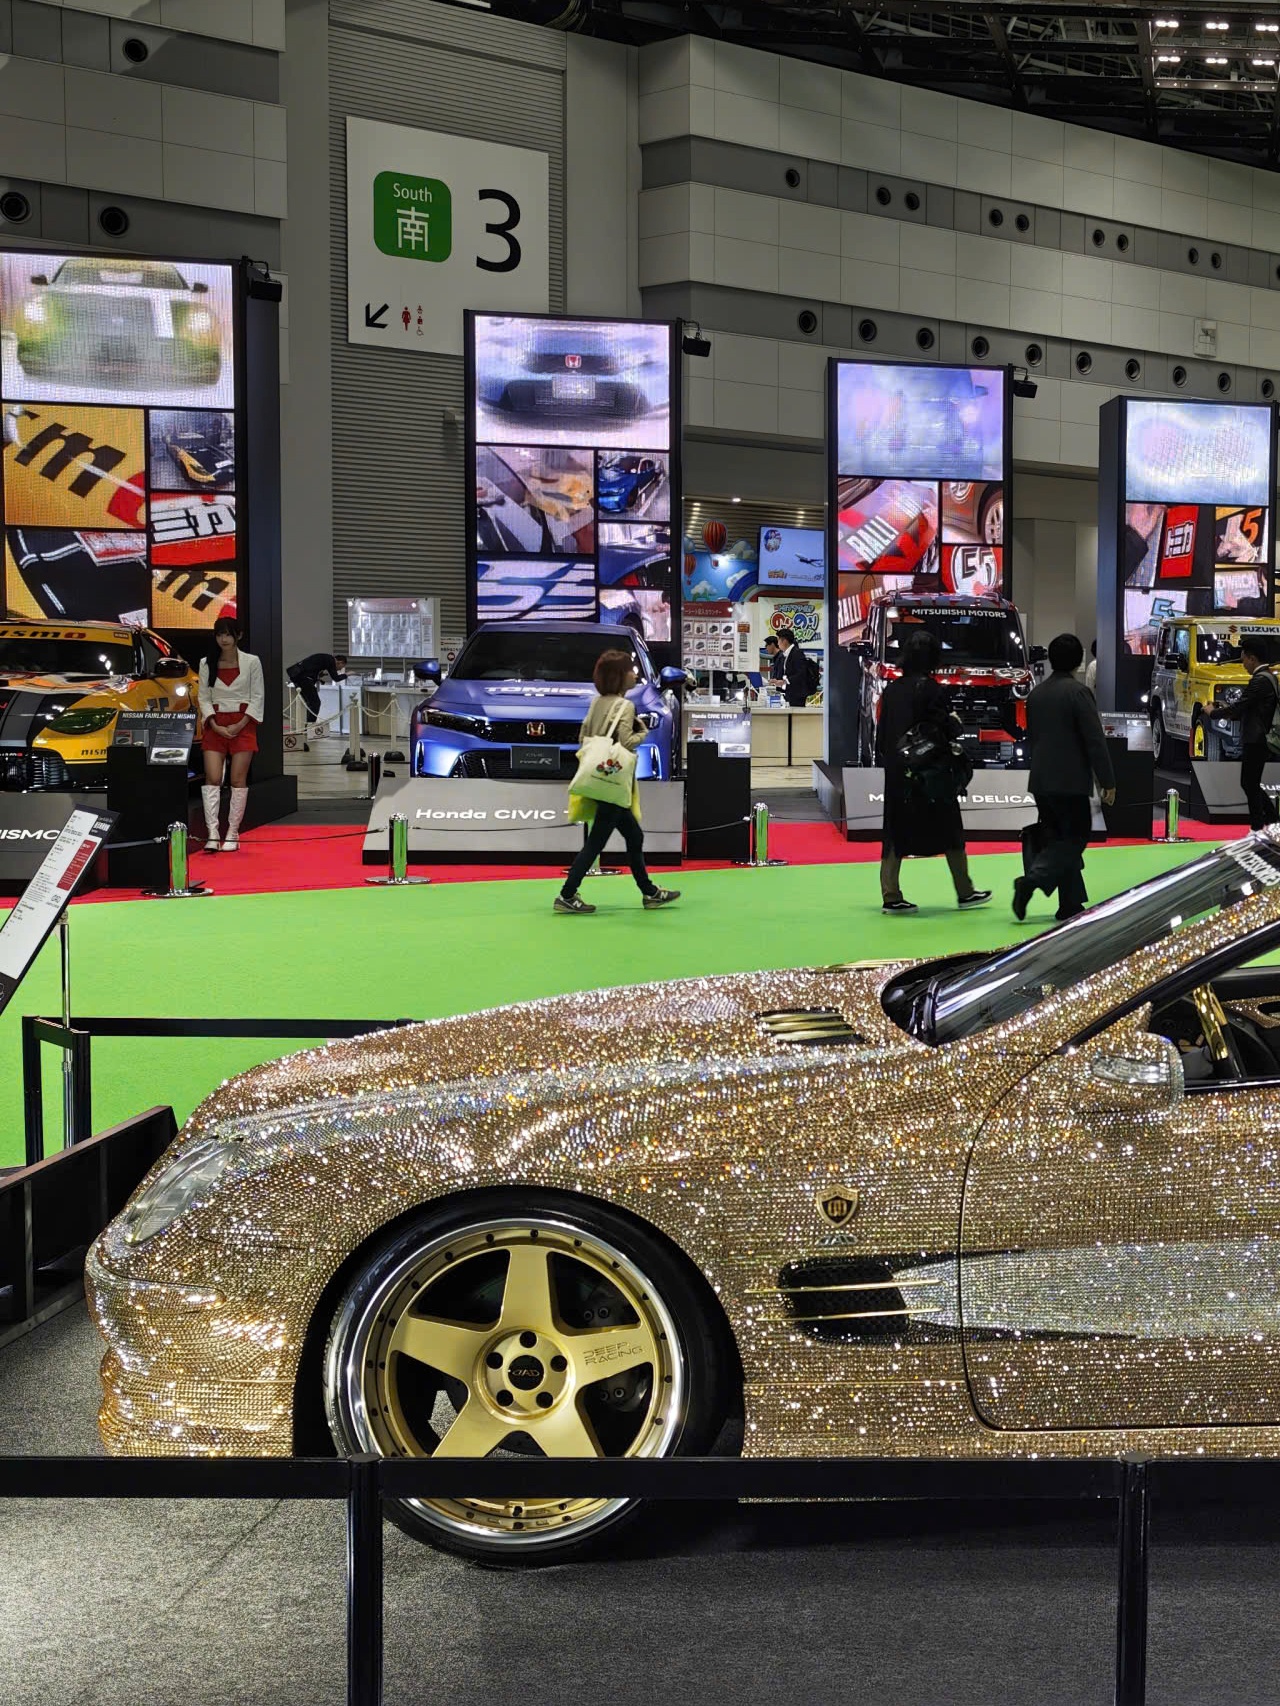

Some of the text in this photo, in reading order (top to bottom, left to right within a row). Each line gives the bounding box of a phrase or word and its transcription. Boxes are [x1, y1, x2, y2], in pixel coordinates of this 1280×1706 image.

[393, 183, 433, 203] South
[396, 206, 430, 252] 南
[476, 188, 522, 273] 3
[846, 515, 899, 564] RALLI
[1163, 520, 1195, 558] トミカ
[911, 608, 1007, 619] MITSUBISHI MOTORS
[0, 629, 86, 639] ismo
[484, 686, 597, 694] TOMICA
[971, 795, 1036, 803] DELICA
[415, 809, 487, 820] Honda
[494, 809, 557, 820] CIVIC
[0, 829, 61, 840] ISMO
